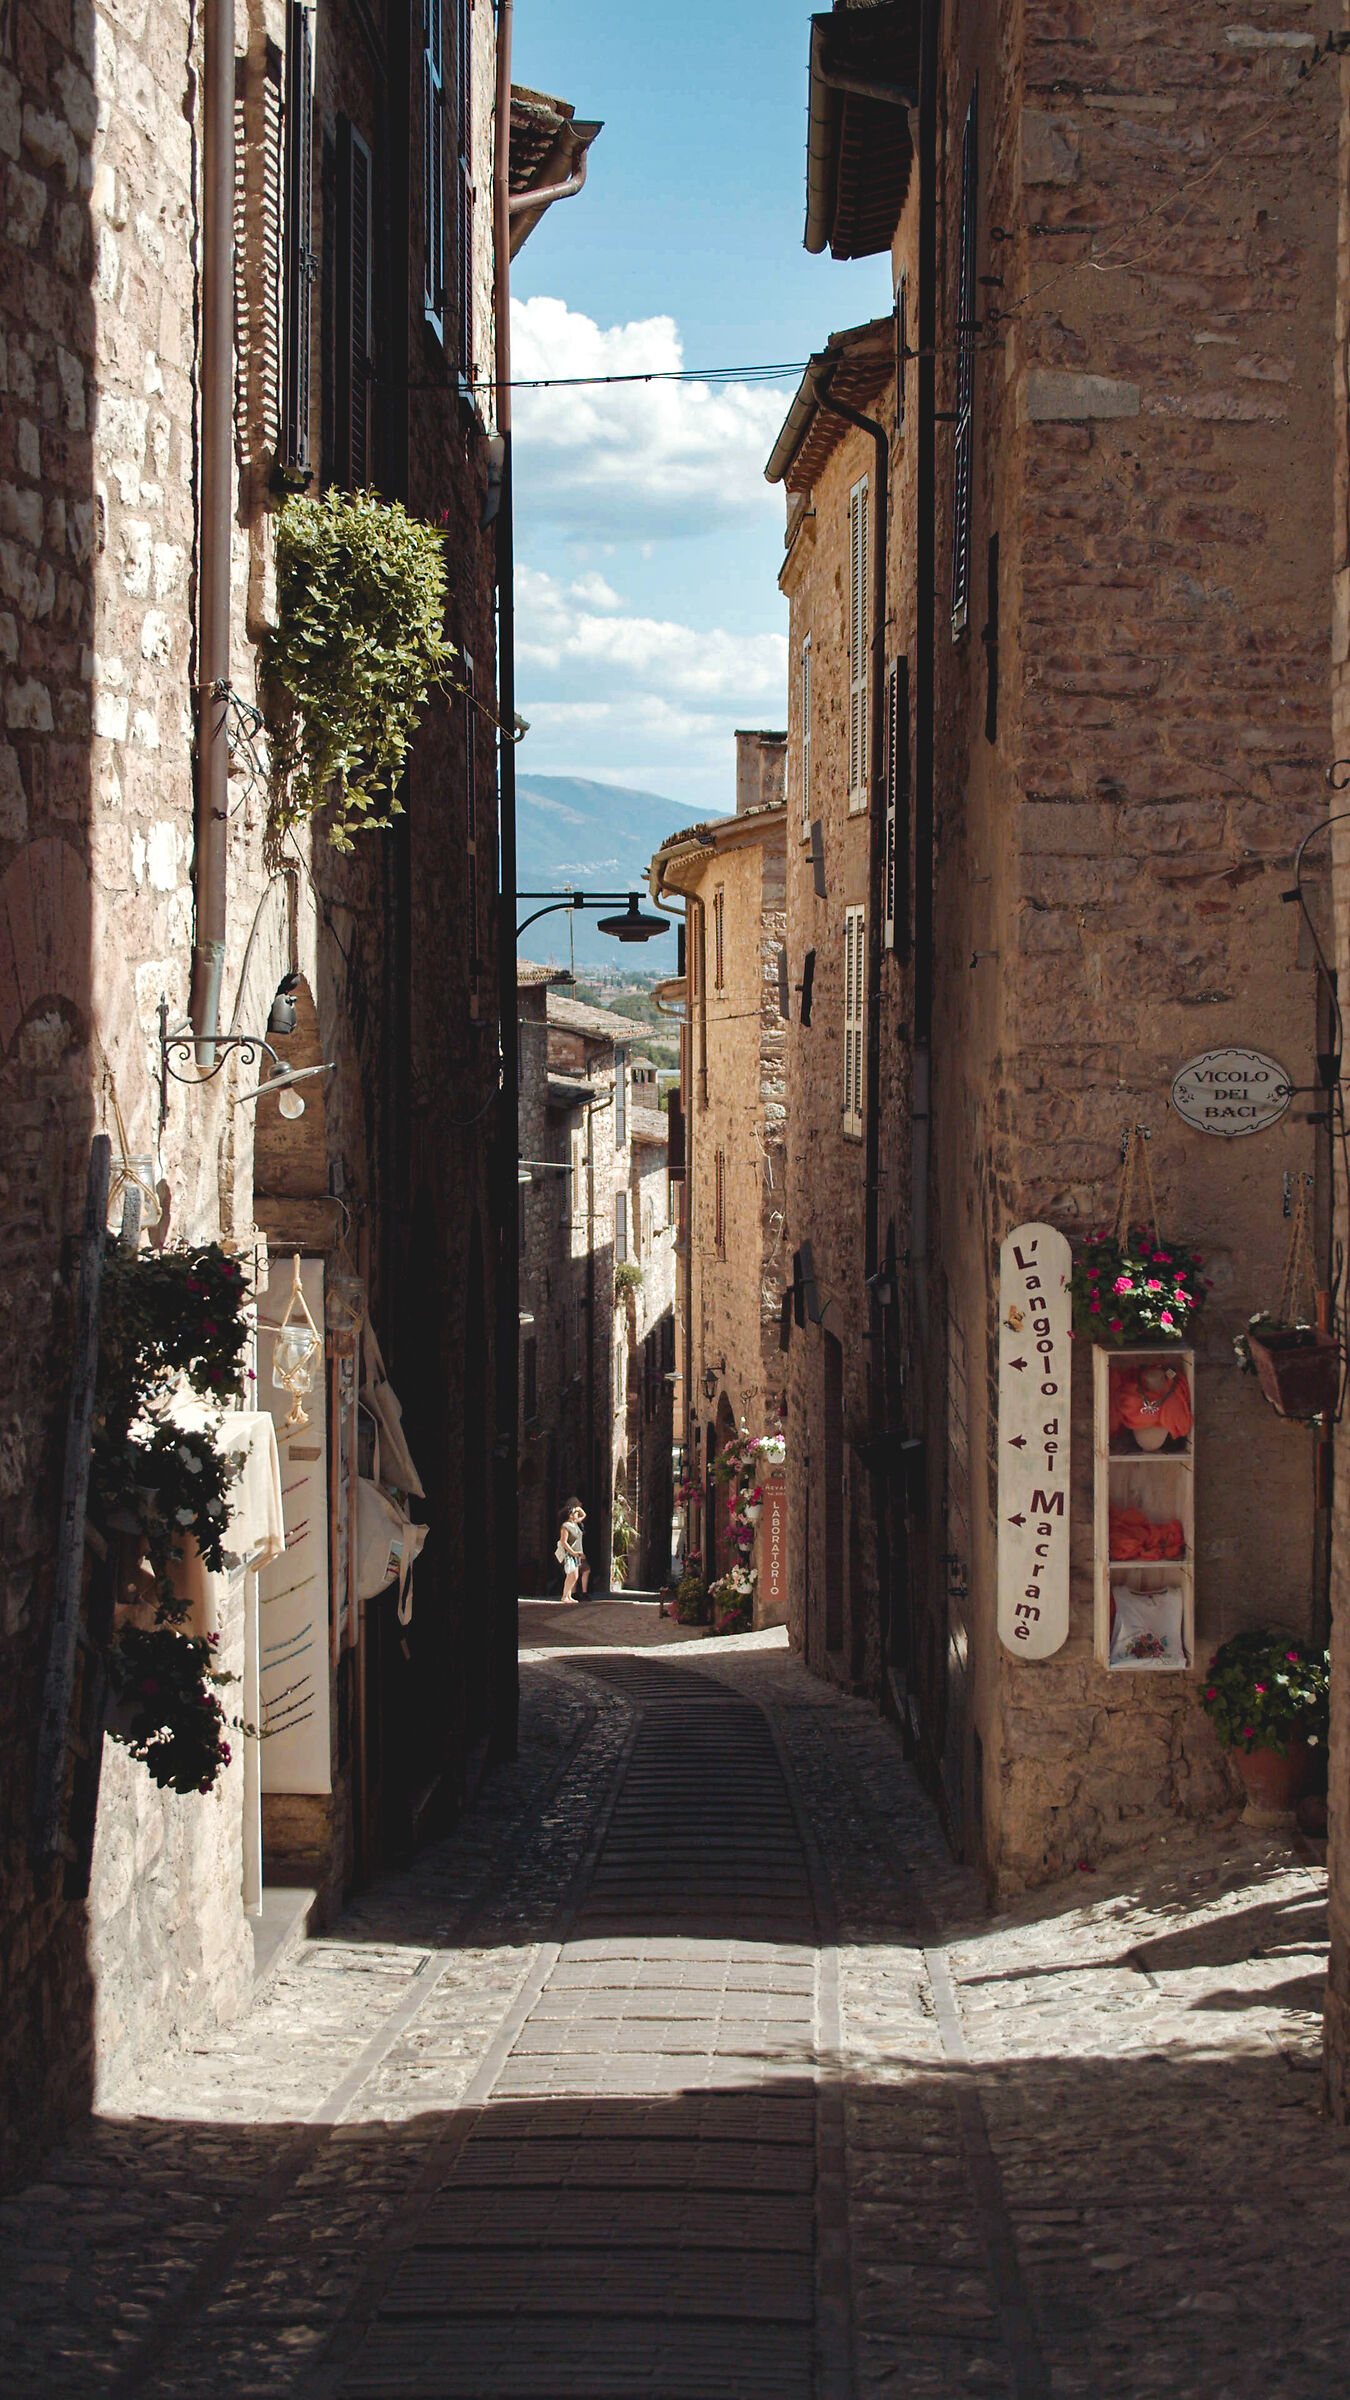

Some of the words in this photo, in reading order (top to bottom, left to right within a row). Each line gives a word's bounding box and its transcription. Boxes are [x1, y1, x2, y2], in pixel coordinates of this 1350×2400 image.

[1194, 1071, 1269, 1083] VICOLO
[1214, 1089, 1249, 1101] DEI
[1205, 1106, 1257, 1118] BACI
[1012, 1240, 1059, 1396] L'angolo
[1043, 1418, 1059, 1471] del
[770, 1501, 781, 1596] LABORATORIO
[1014, 1489, 1065, 1641] Macramè
